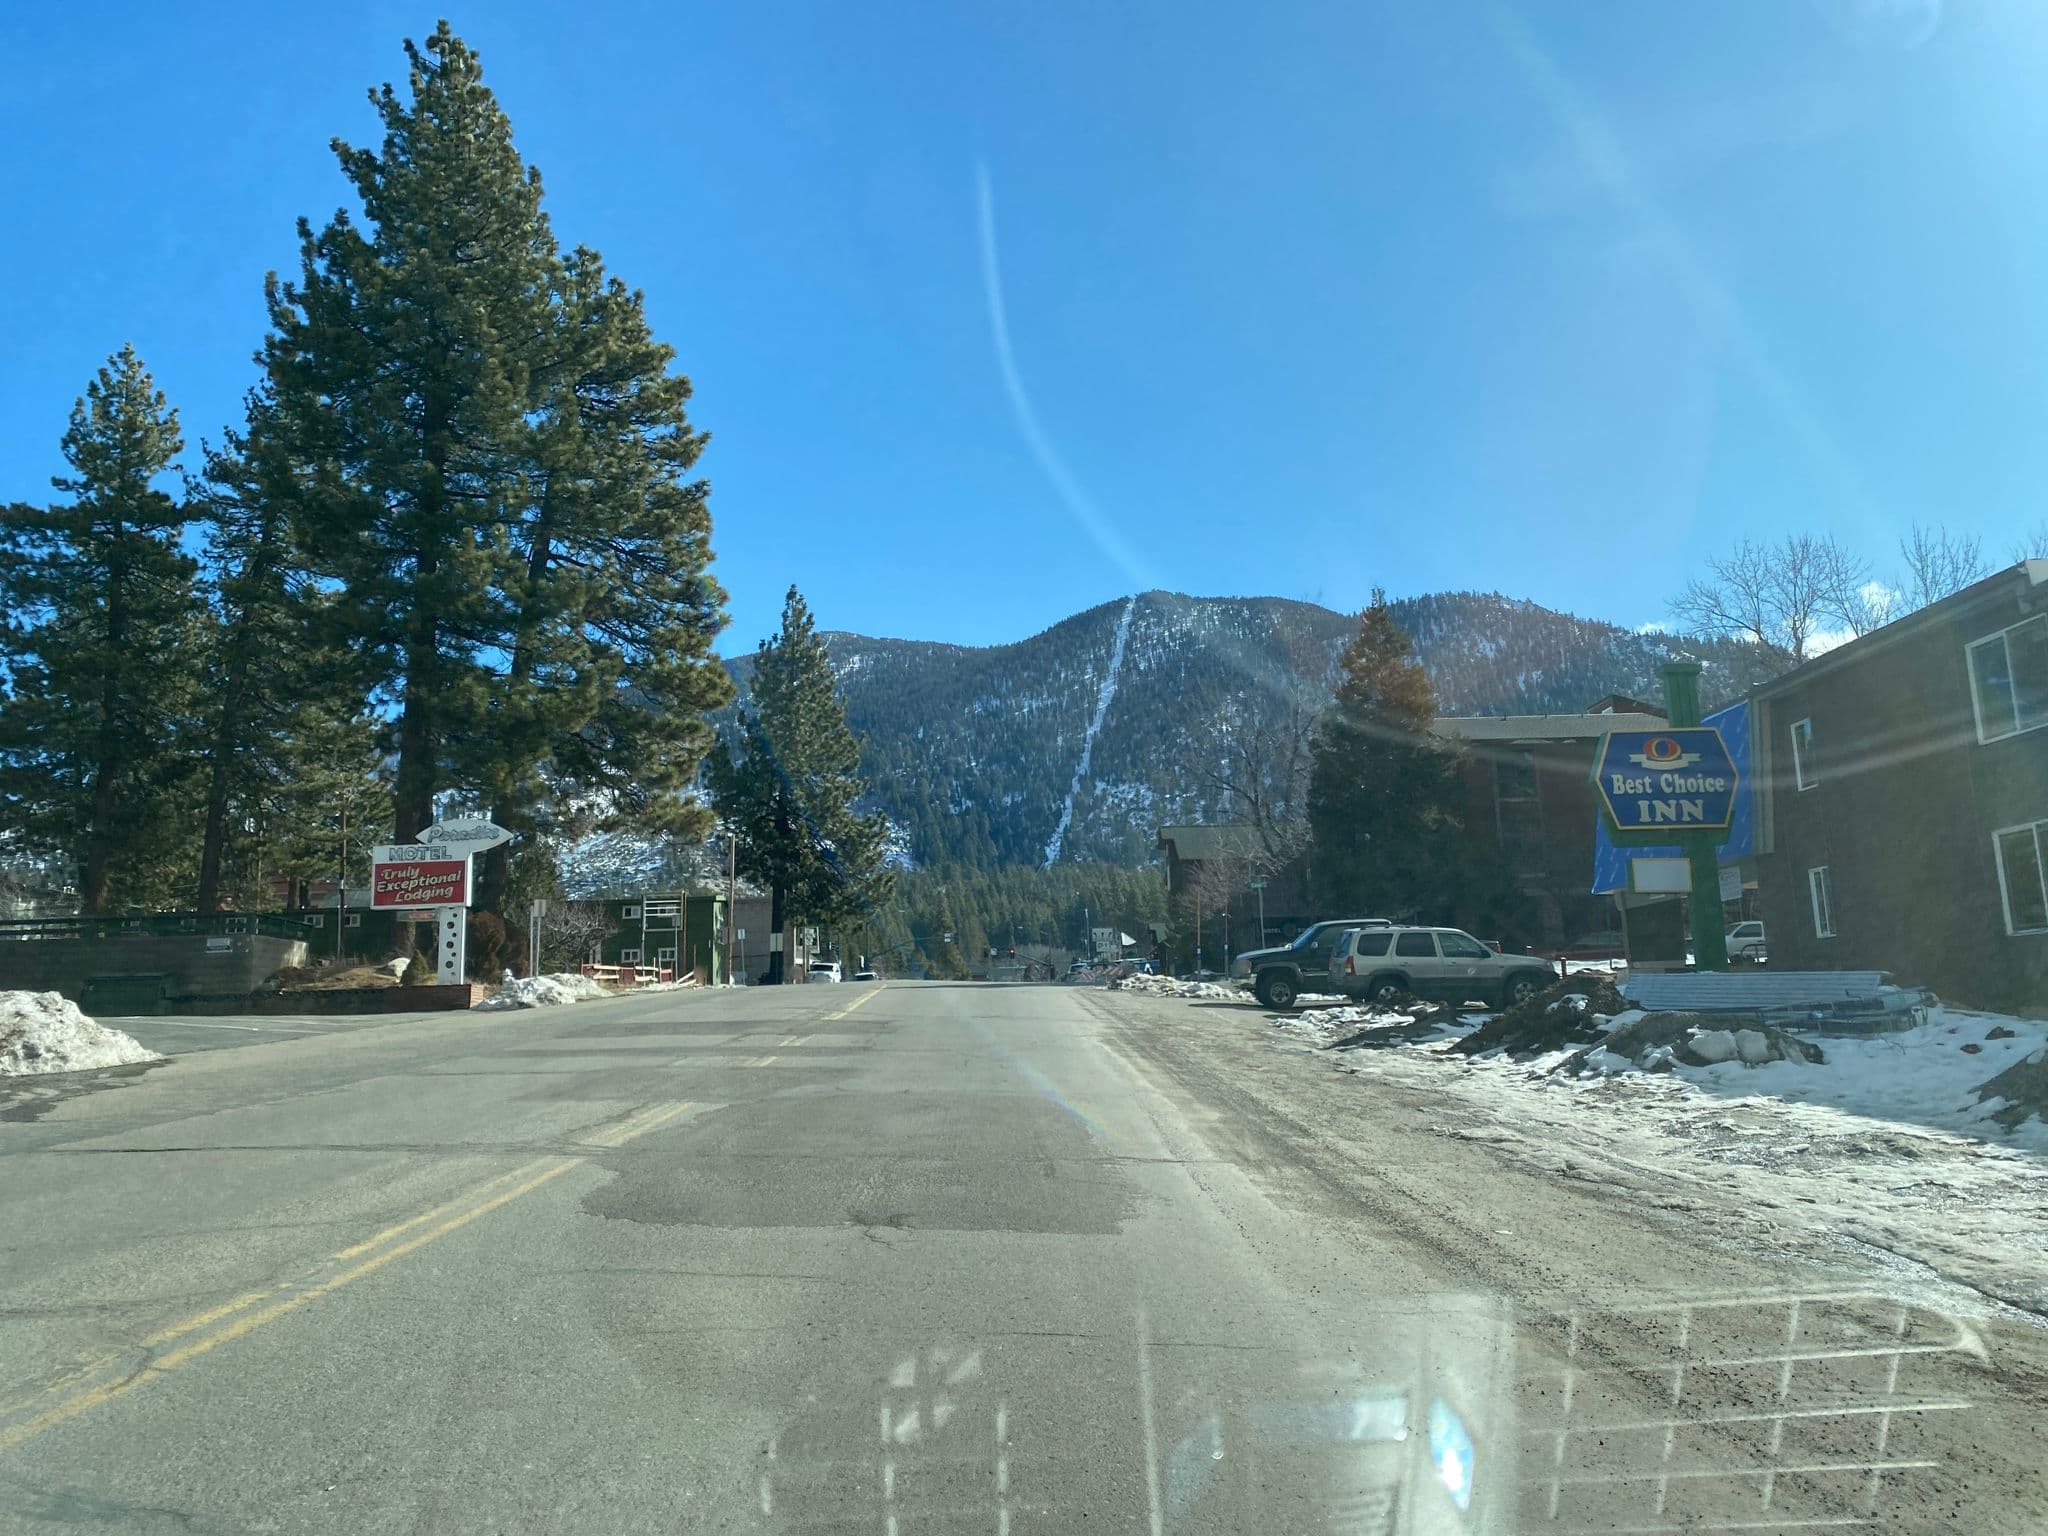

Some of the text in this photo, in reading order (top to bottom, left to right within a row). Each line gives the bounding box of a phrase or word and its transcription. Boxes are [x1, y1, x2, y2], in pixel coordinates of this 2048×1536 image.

[1611, 773, 1726, 795] Best Choice
[1638, 799, 1704, 823] INN
[388, 846, 452, 862] MOTEL
[376, 870, 462, 892] Exceptional
[381, 866, 420, 879] Truly
[394, 886, 454, 902] Lodging
